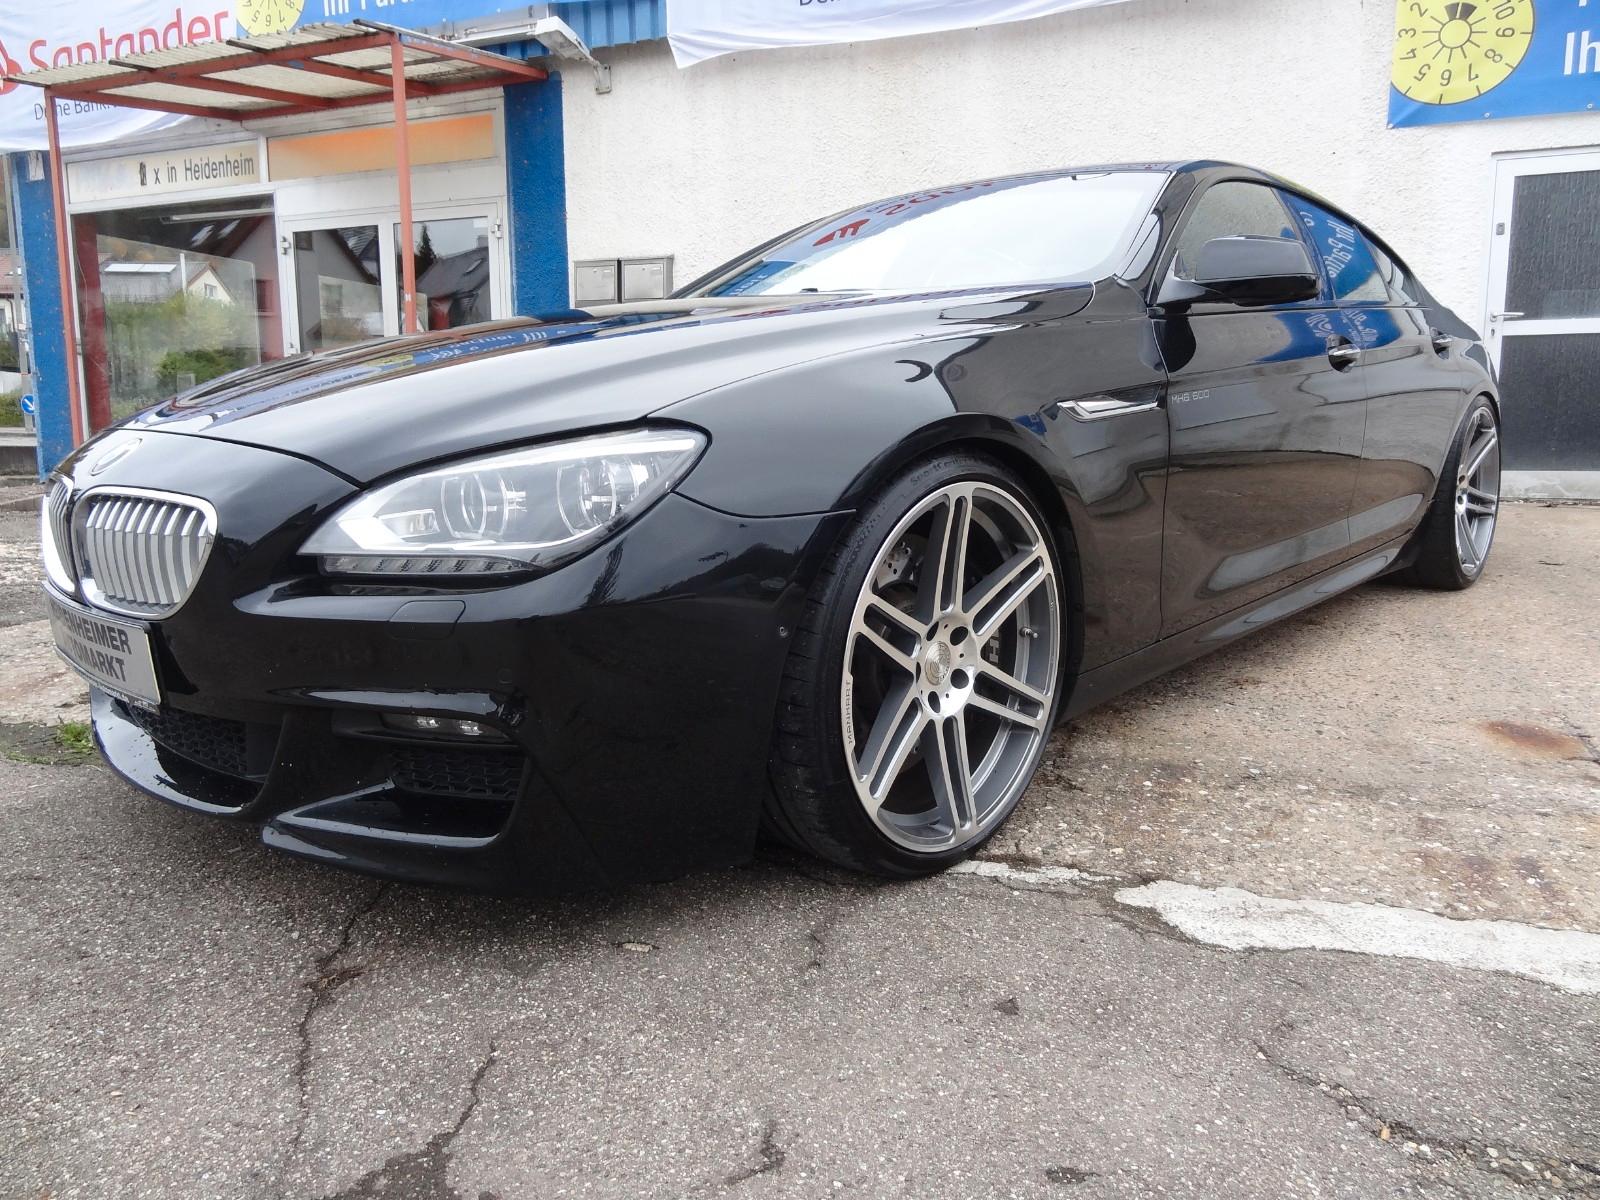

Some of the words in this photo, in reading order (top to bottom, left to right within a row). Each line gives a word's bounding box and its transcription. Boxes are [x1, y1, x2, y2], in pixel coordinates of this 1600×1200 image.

[34, 100, 70, 120] Dne
[154, 167, 161, 185] x
[167, 161, 177, 183] in
[184, 153, 255, 181] Heidenheim
